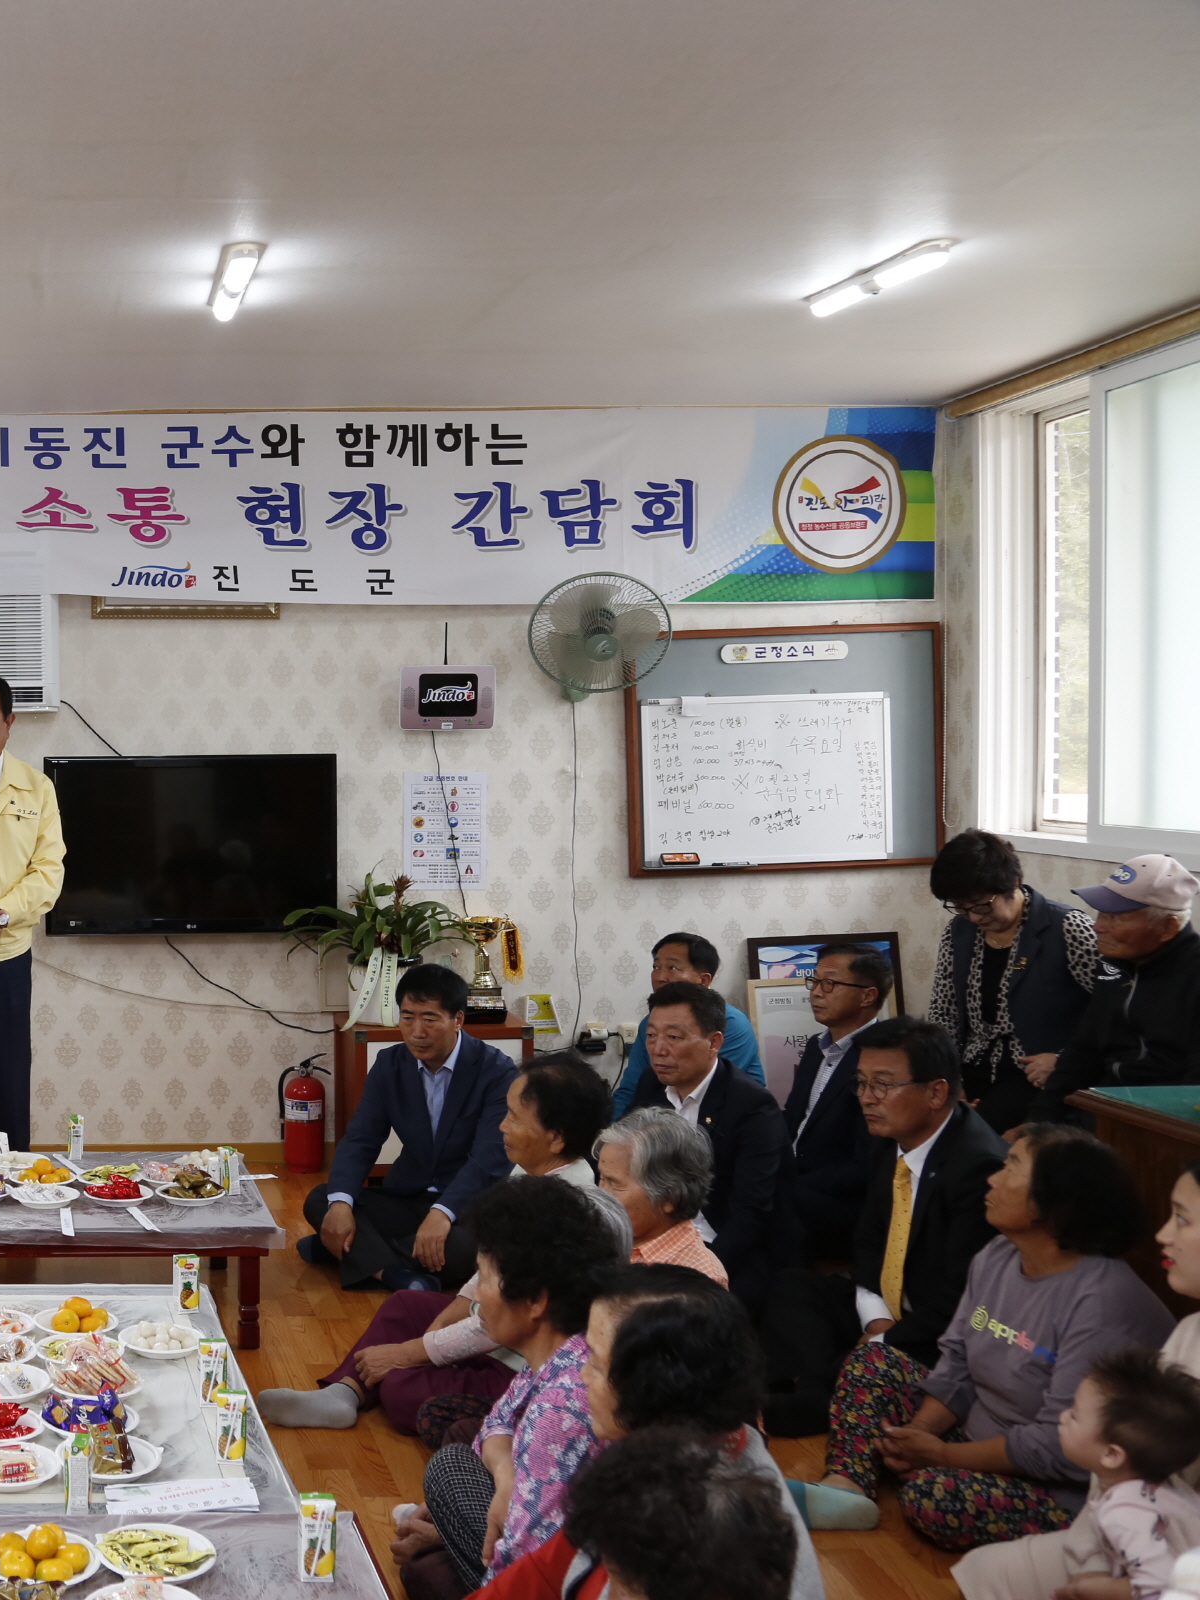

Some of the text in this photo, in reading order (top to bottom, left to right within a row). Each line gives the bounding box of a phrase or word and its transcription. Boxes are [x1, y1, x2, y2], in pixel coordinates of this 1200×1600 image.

[160, 424, 305, 468] 군수와
[336, 422, 527, 468] 함께하는
[14, 486, 188, 545] 소통
[236, 481, 404, 551] 현장
[453, 479, 698, 551] 간담회
[111, 566, 183, 589] Jindo
[422, 689, 466, 703] Jindo
